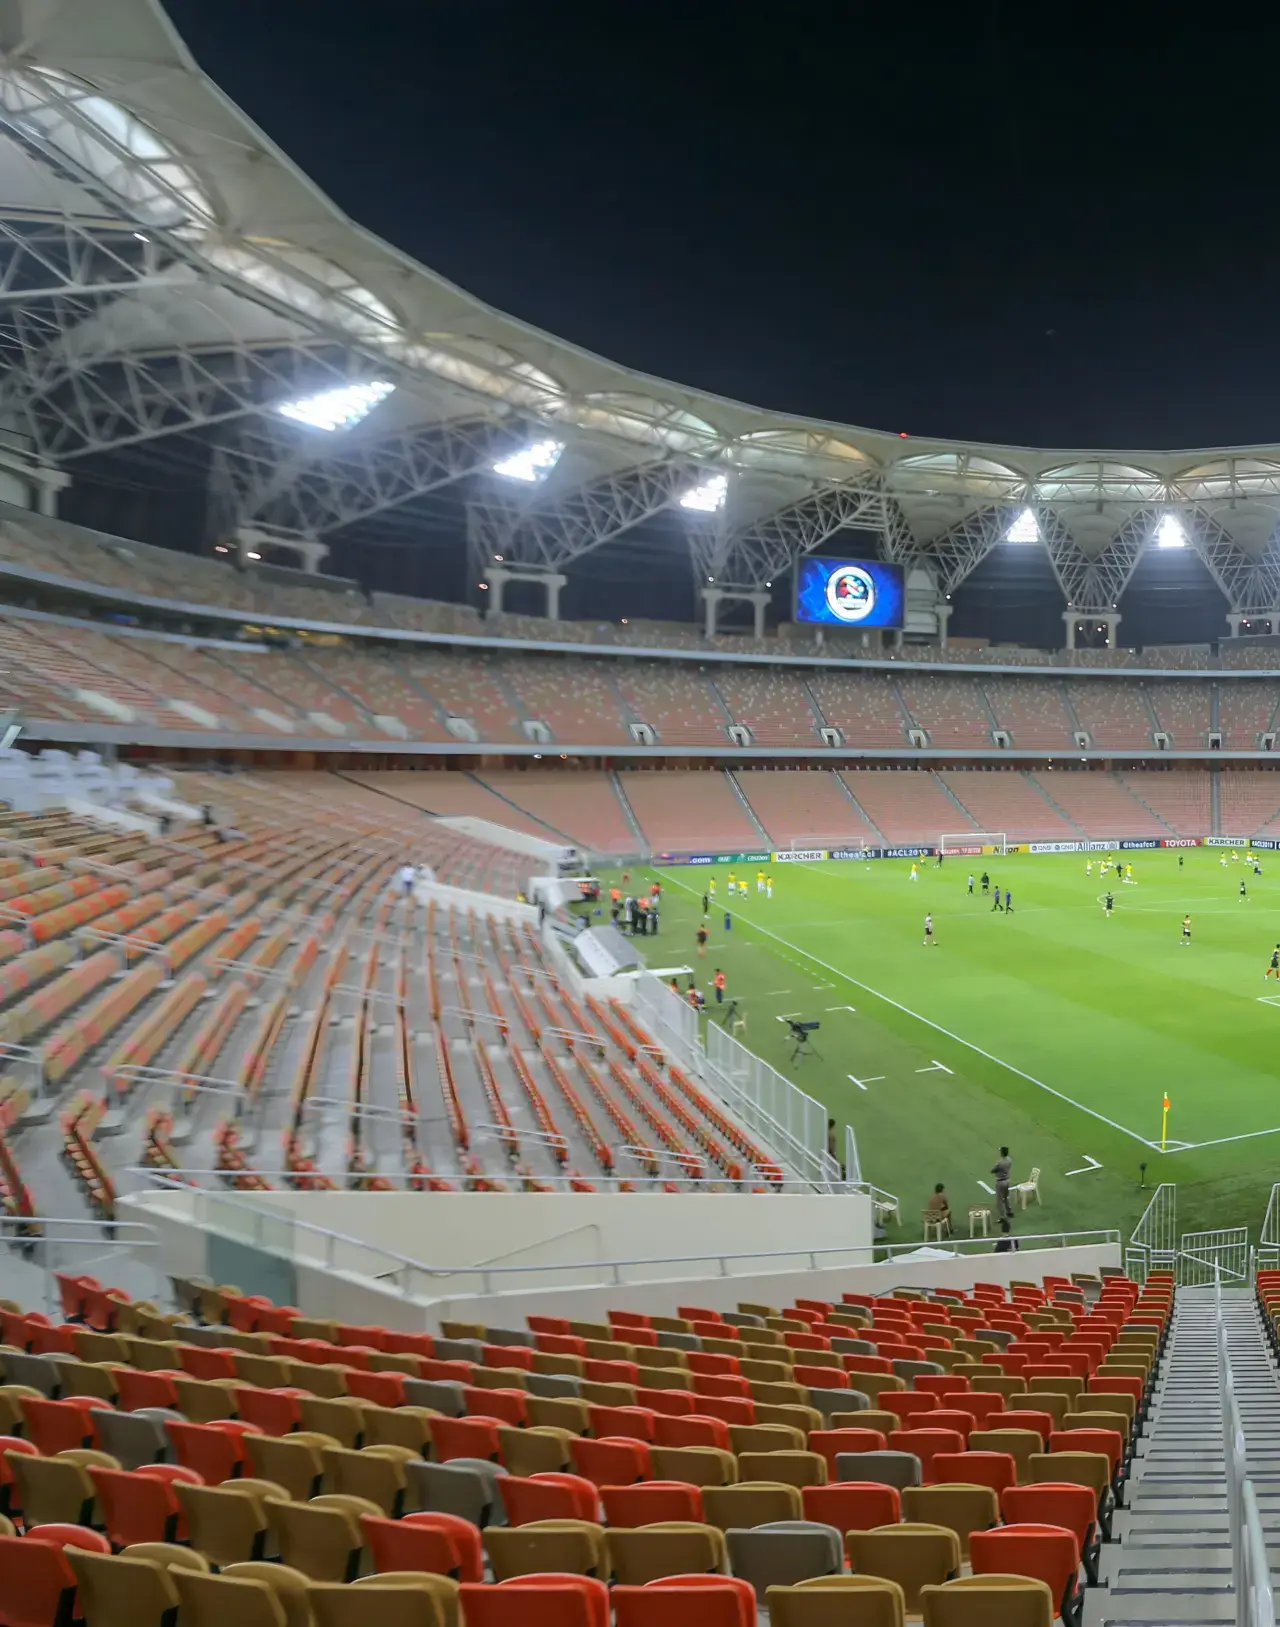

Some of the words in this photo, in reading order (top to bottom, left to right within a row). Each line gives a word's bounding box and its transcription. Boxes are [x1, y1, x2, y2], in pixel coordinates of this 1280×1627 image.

[1077, 842, 1106, 851] Allianz
[1164, 839, 1197, 848] TOYOTA
[887, 848, 929, 857] #ACL2019
